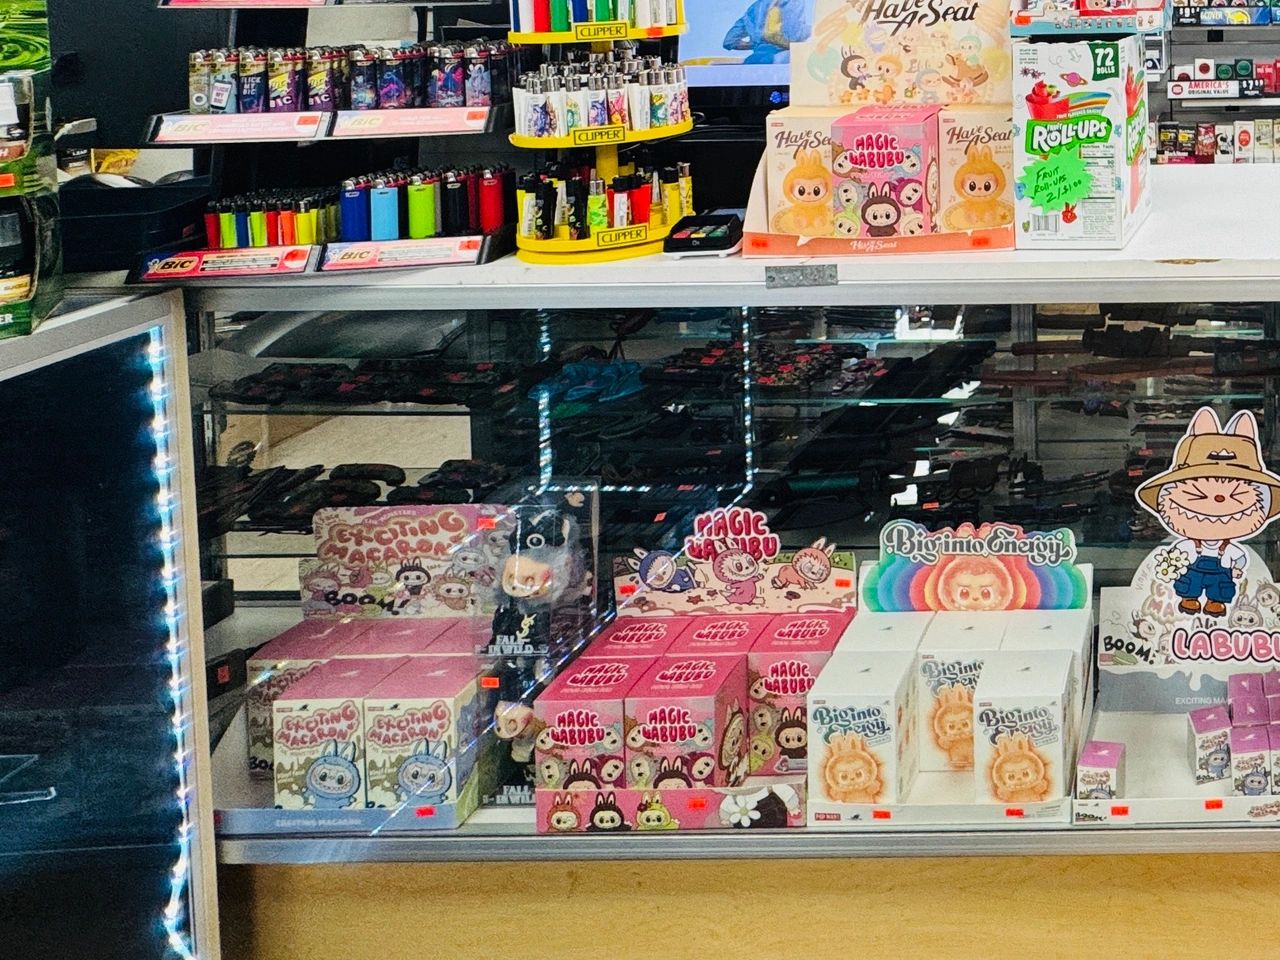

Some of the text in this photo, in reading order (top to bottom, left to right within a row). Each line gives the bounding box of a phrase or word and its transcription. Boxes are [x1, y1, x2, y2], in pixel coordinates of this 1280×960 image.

[580, 24, 625, 37] CLIPPER
[1095, 47, 1114, 66] 72
[1096, 65, 1115, 74] ROLLS
[1188, 81, 1229, 89] AMERICA'S
[578, 128, 623, 141] CLIPPER
[855, 133, 898, 151] MAGIC
[1032, 120, 1108, 152] ROLL-UPS
[849, 150, 904, 169] LABUBU
[1036, 166, 1060, 183] FRUIT
[602, 230, 646, 244] CLIPPER
[335, 510, 466, 544] EXCITING
[695, 510, 769, 537] MAGIC
[884, 526, 1072, 566] Big into Energy
[770, 661, 810, 678] MAGIC
[764, 677, 815, 695] LABUBU
[557, 709, 600, 728] MAGIC
[550, 726, 604, 745] LABUBU
